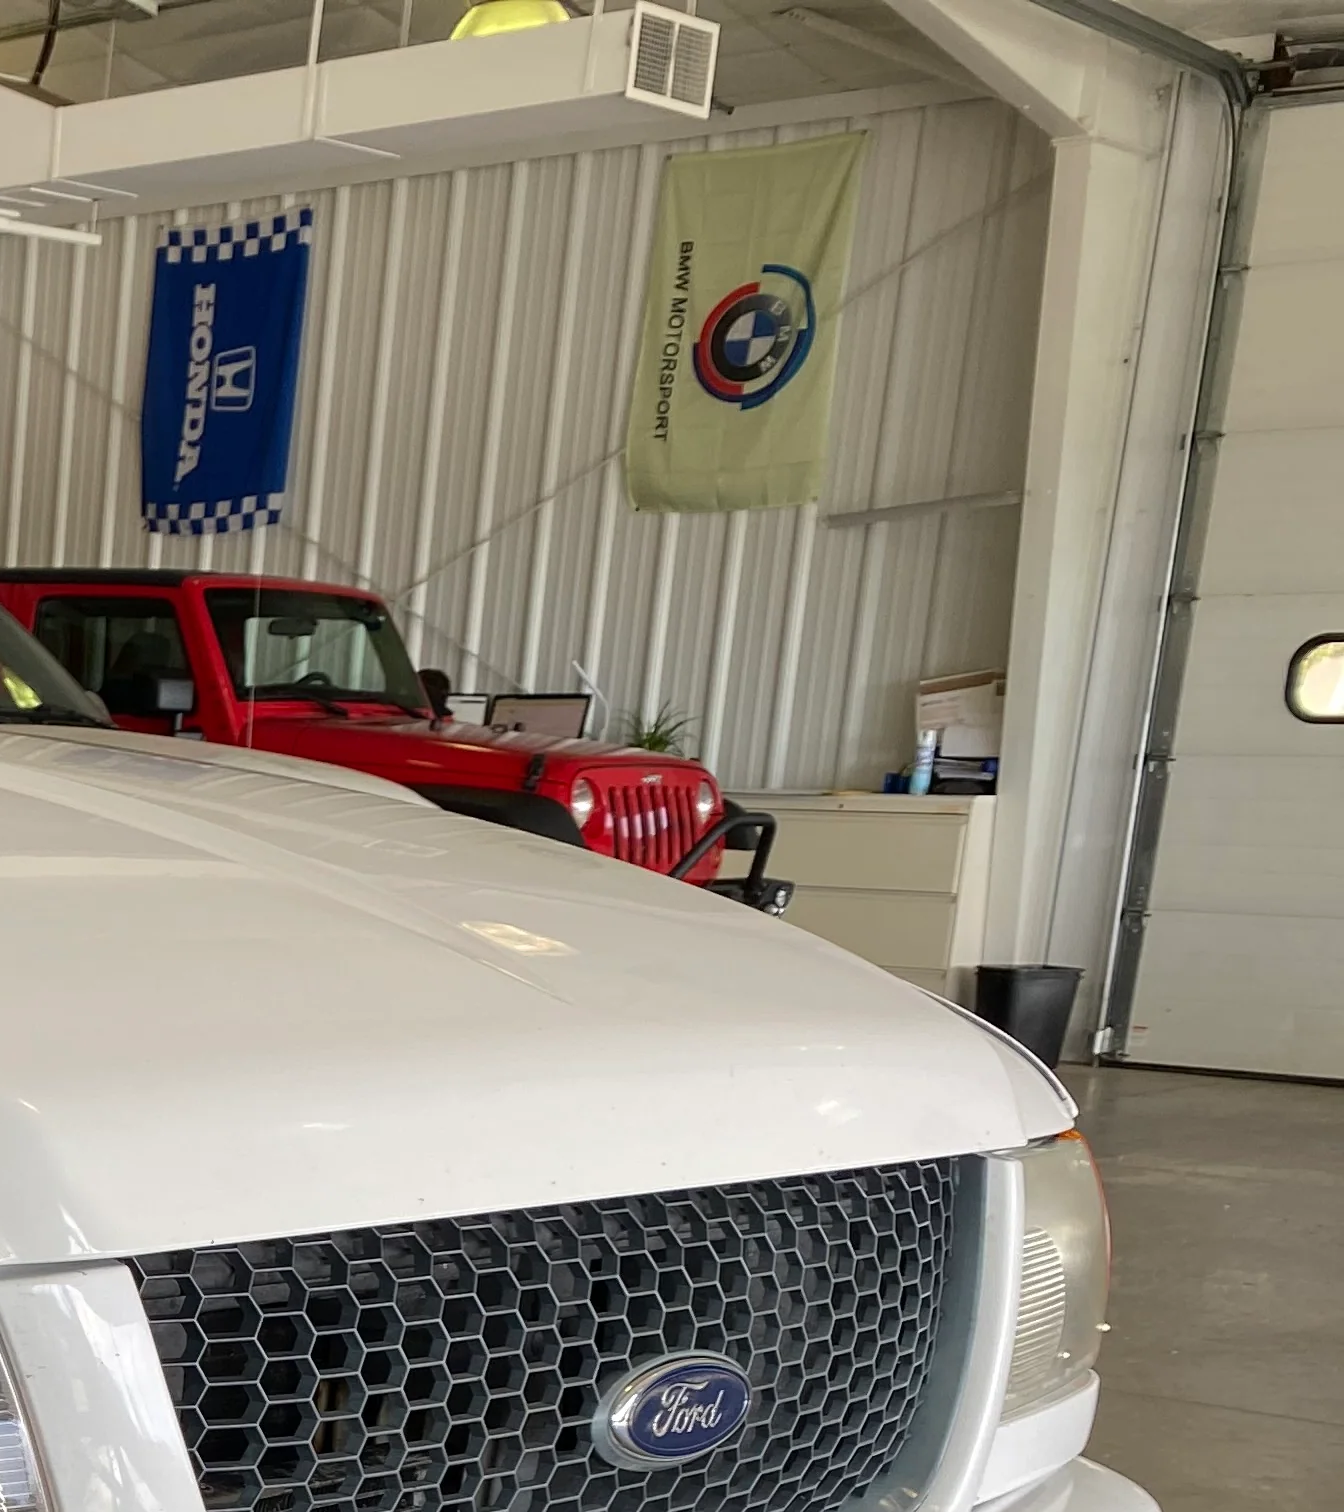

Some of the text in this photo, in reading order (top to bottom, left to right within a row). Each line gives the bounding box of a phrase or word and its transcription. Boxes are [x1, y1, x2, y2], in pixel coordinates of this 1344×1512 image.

[173, 283, 216, 483] HONDA
[652, 240, 695, 443] BMW MOTORSPORT
[651, 1379, 725, 1438] Ford
